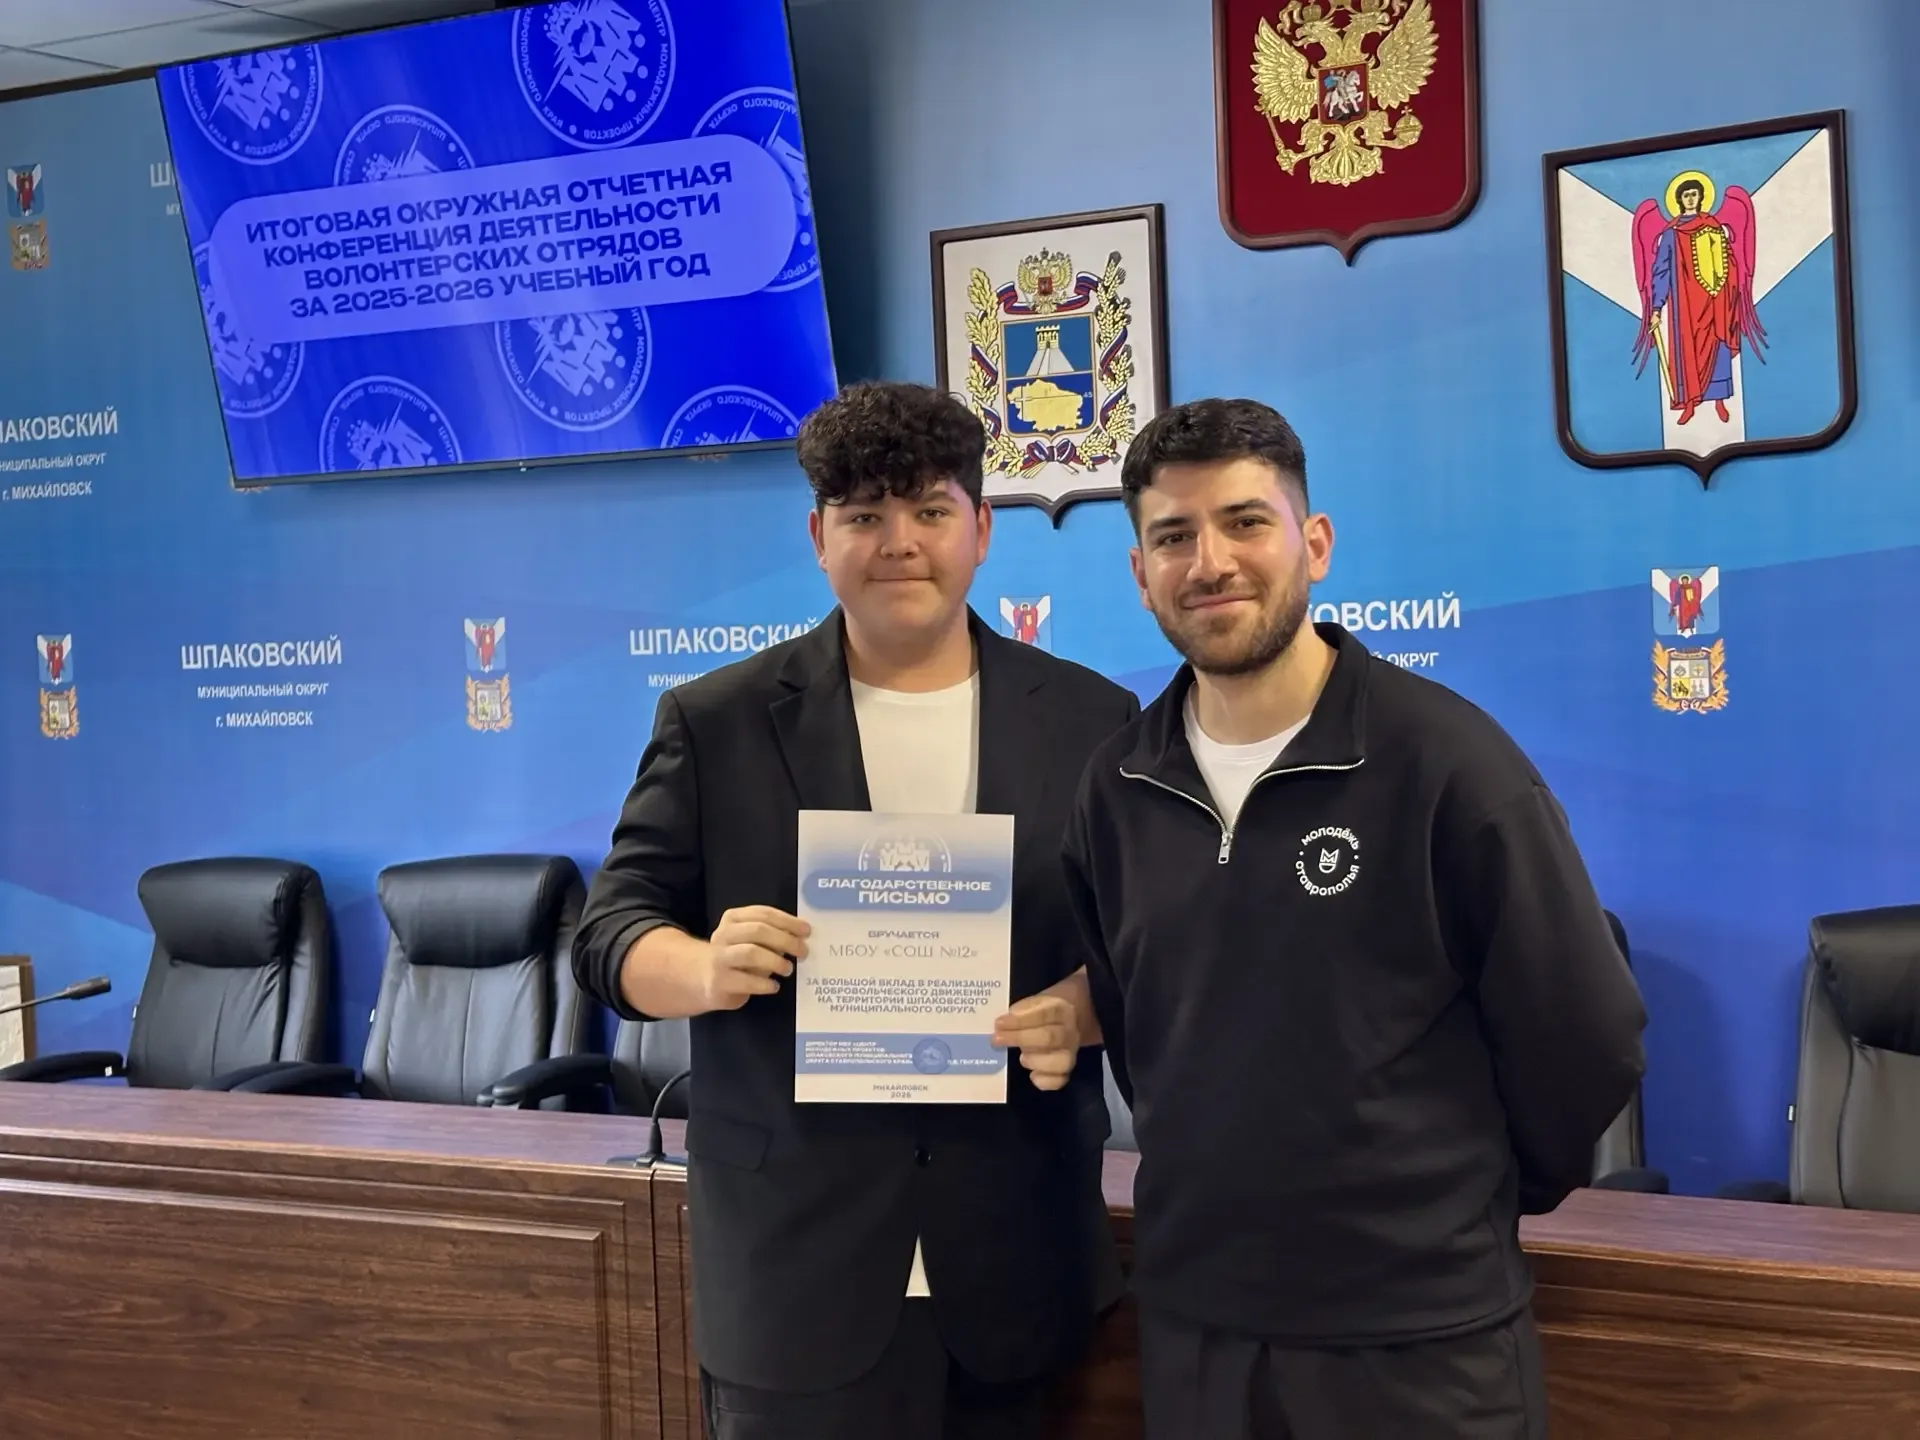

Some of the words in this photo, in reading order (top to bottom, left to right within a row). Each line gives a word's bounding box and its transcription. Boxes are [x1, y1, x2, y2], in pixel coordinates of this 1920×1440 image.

[708, 103, 738, 130] ОКРУГА
[743, 98, 798, 116] АКОВСКОГО
[542, 106, 563, 129] КРАЯ
[355, 119, 381, 143] ОКРУГА
[384, 115, 446, 141] ШПАКОВСКОГО
[583, 120, 633, 140] ПРОЕКТОВ
[246, 206, 392, 243] ИТОГОВАЯ
[397, 184, 561, 224] ОКРУЖНАЯ
[567, 161, 732, 202] ОТЧЕТНАЯ
[264, 224, 472, 268] КОНФЕРЕНЦИЯ
[478, 192, 721, 245] ДЕЯТЕЛЬНОСТИ
[304, 245, 531, 290] ВОЛОНТЕРСКИХ
[536, 227, 683, 263] ОТРЯДОВ
[290, 296, 328, 318] ЗА
[333, 277, 494, 314] 2025-2026
[499, 256, 643, 295] УЧЕБНЫЙ
[648, 253, 711, 280] ГОД
[716, 395, 784, 424] ШПАКОВСКОГО
[75, 452, 106, 467] ОКРУГ
[12, 480, 93, 500] МИХАЙЛОВСК
[1308, 591, 1460, 632] ОВСКИЙ
[181, 634, 342, 669] ШПАКОВСКИЙ
[197, 682, 293, 699] МУНИЦИПАЛЬНЫЙ
[295, 683, 329, 696] ОКРУГ
[216, 716, 224, 727] г.
[226, 710, 313, 728] МИХАЙЛОВСК
[818, 878, 992, 891] БЛАГОДАРСТВЕННОЕ
[859, 891, 950, 904] ПИСЬМО
[868, 930, 940, 939] ВРУЧАЕТСЯ
[829, 944, 878, 958] МБОУ
[883, 945, 933, 958] «СОШ
[806, 978, 819, 986] ЗА
[821, 976, 876, 987] БОЛЬШОЙ
[878, 979, 915, 988] ВКЛАД
[927, 979, 1001, 988] РЕАЛИЗАЦИЮ
[815, 986, 928, 996] ДОБРОВОЛЬЧЕСКОГО
[930, 988, 991, 997] ДВИЖЕНИЯ
[818, 995, 833, 1004] НА
[907, 996, 988, 1006] ШПАКОВСКОГО
[830, 1004, 932, 1014] МУНИЦИПАЛЬНОГО
[935, 1005, 976, 1014] ОКРУГА
